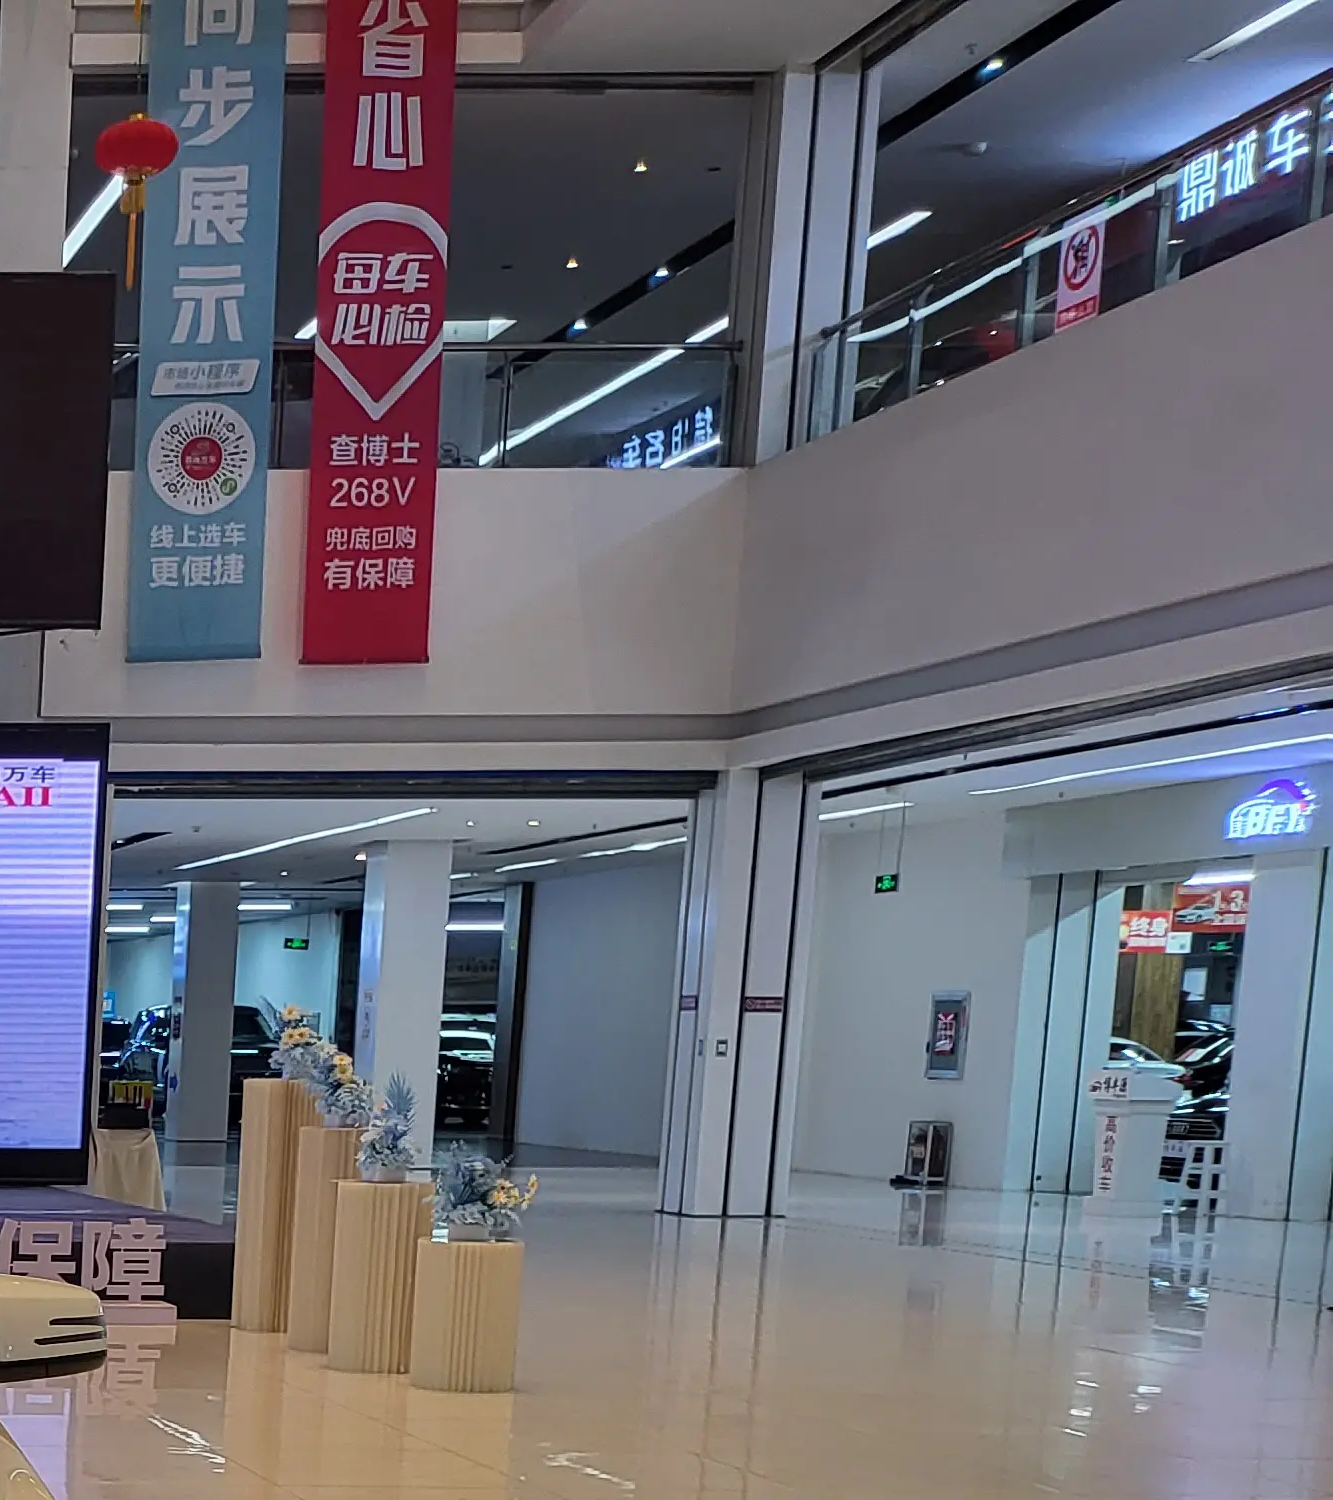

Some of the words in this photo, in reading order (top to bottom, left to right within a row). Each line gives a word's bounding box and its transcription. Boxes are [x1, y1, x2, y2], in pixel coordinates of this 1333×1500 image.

[353, 0, 429, 170] 省心
[333, 252, 433, 294] 每车
[331, 303, 431, 345] 必检
[329, 432, 421, 467] 查博士
[329, 476, 416, 508] 268V
[150, 522, 247, 550] 线上选车
[325, 525, 416, 551] 兜底回购
[149, 553, 245, 588] 更便捷
[323, 556, 416, 590] 有保障
